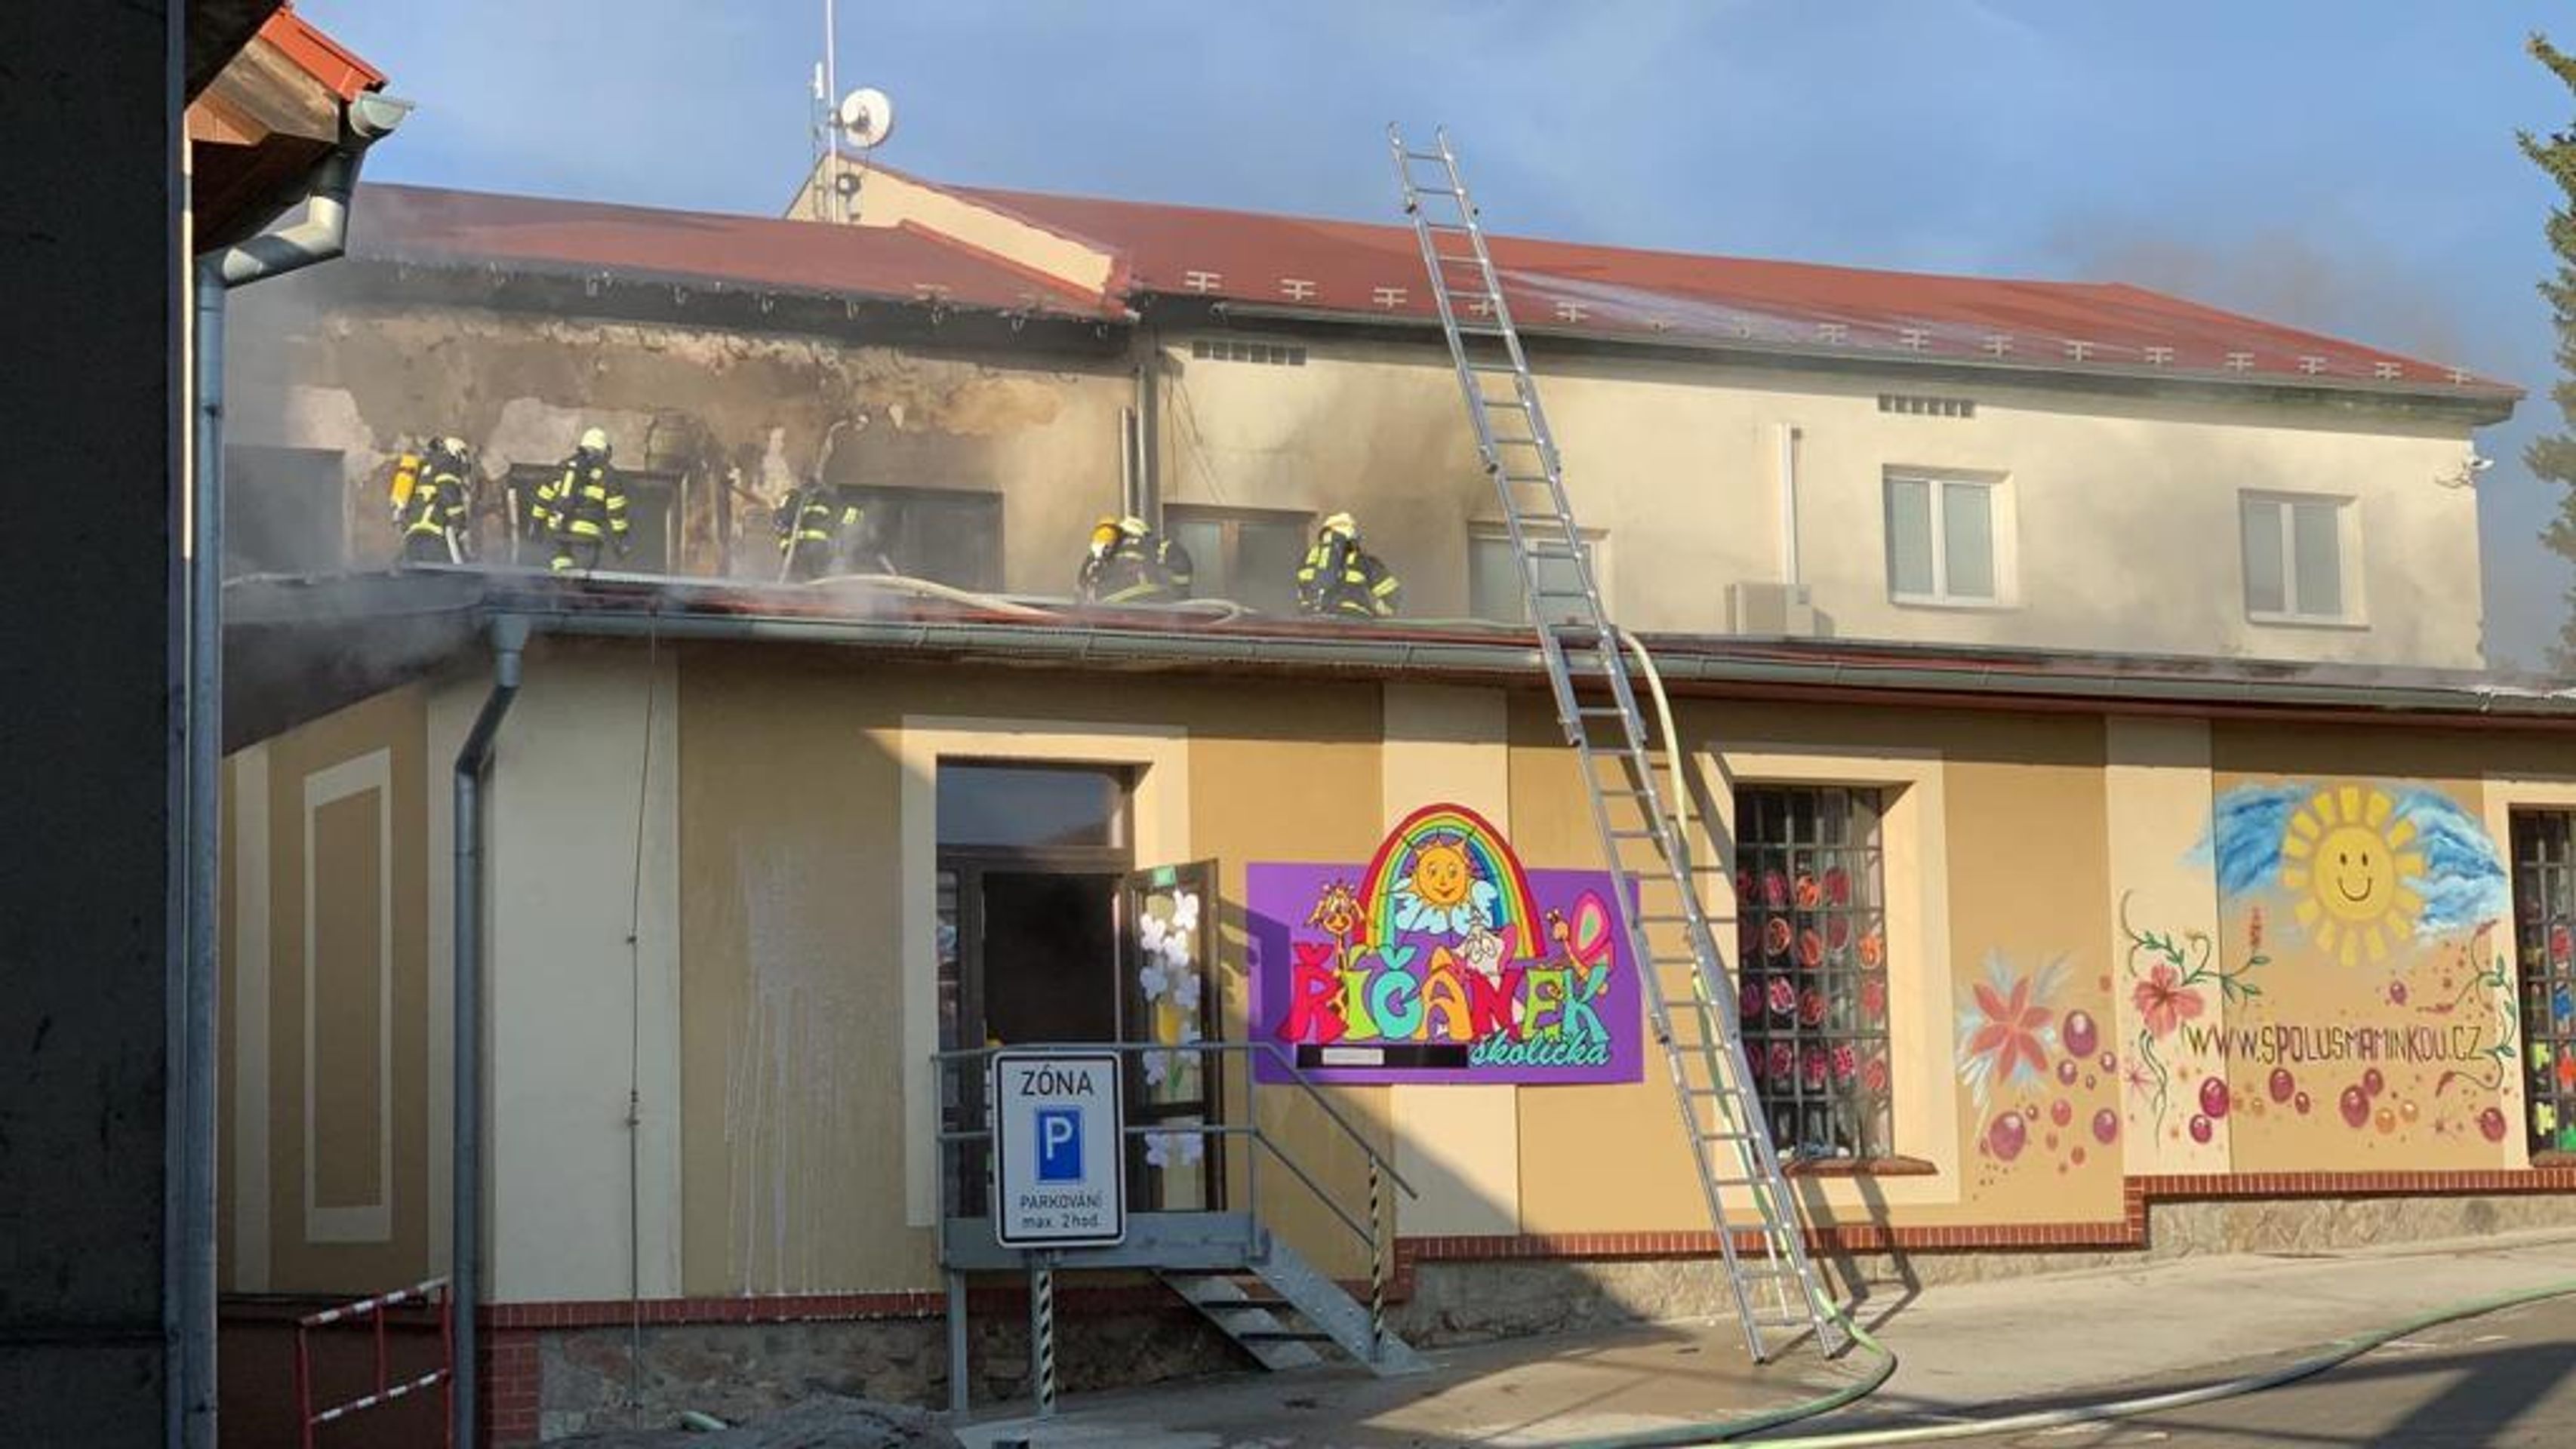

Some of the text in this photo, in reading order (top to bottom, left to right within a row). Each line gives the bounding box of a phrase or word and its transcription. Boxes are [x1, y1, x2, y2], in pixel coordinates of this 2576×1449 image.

[1470, 1028, 1610, 1068] školička
[2187, 1024, 2483, 1064] WWW.SPOLUSMAMINKOU.CZ
[1020, 1064, 1094, 1096] ZÓNA
[1046, 1116, 1073, 1160] P
[1020, 1191, 1102, 1209] PARKOVÁNÍ
[1022, 1217, 1054, 1229] max.
